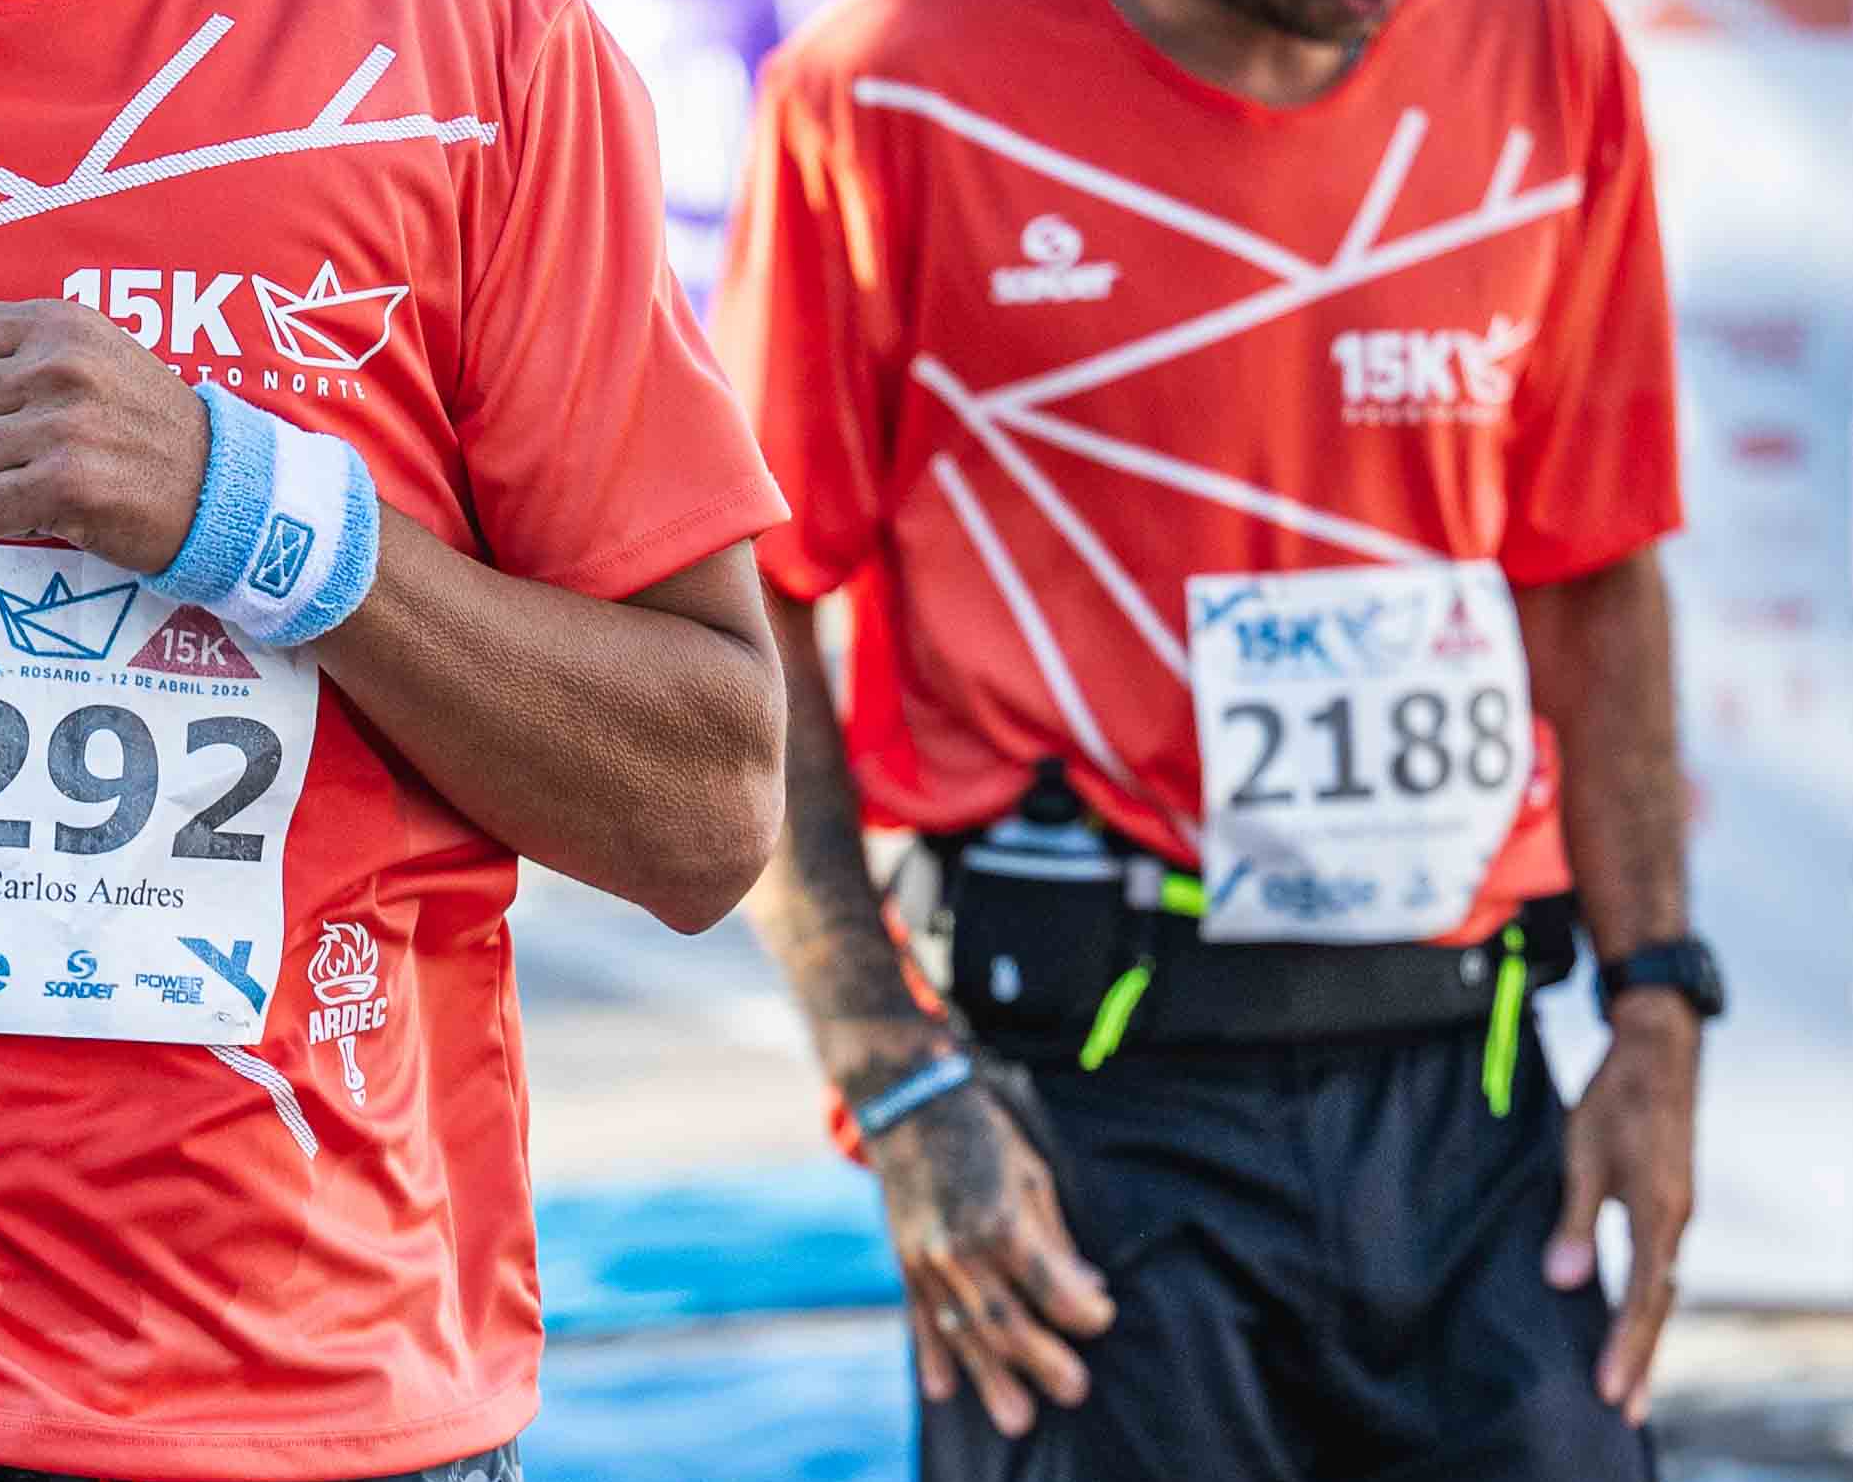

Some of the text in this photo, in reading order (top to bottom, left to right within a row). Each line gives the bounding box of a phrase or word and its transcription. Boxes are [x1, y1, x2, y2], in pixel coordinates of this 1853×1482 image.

[1331, 330, 1459, 402] 15K
[264, 370, 365, 399] NORTE
[161, 628, 228, 666] 15K
[20, 665, 91, 684] ROSARIO
[111, 673, 128, 685] 12
[135, 675, 152, 689] DE
[158, 680, 204, 695] ABRIL
[212, 684, 250, 697] 2026
[1222, 685, 1513, 810] 2188
[87, 877, 185, 908] Andres
[135, 973, 205, 991] POWER
[308, 997, 388, 1046] ARDEC
